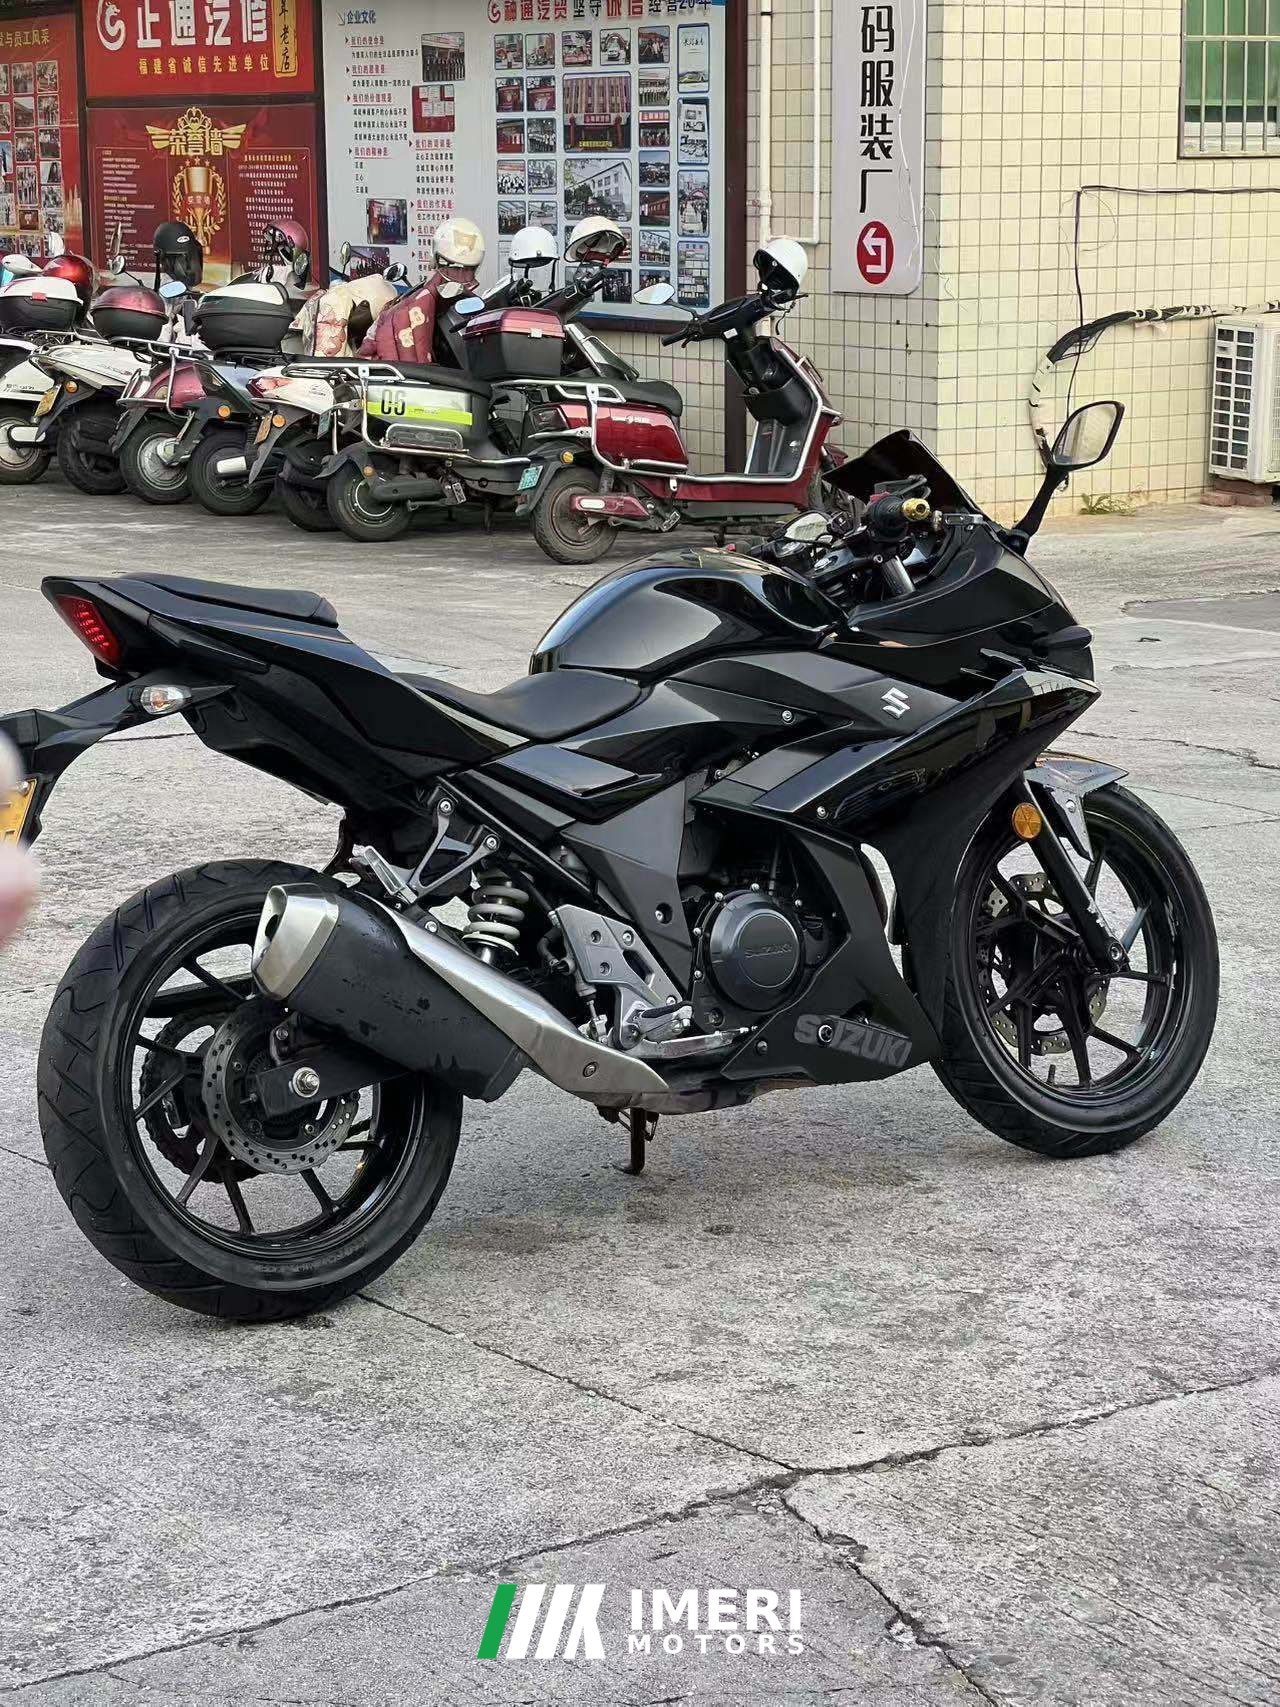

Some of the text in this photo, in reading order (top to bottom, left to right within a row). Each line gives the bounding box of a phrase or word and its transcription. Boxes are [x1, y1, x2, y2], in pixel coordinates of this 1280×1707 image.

[347, 10, 376, 24] 企业文化
[138, 54, 270, 75] 福建省诚信先进单位
[859, 5, 895, 214] 码服装厂
[169, 128, 224, 156] 荣誉墙
